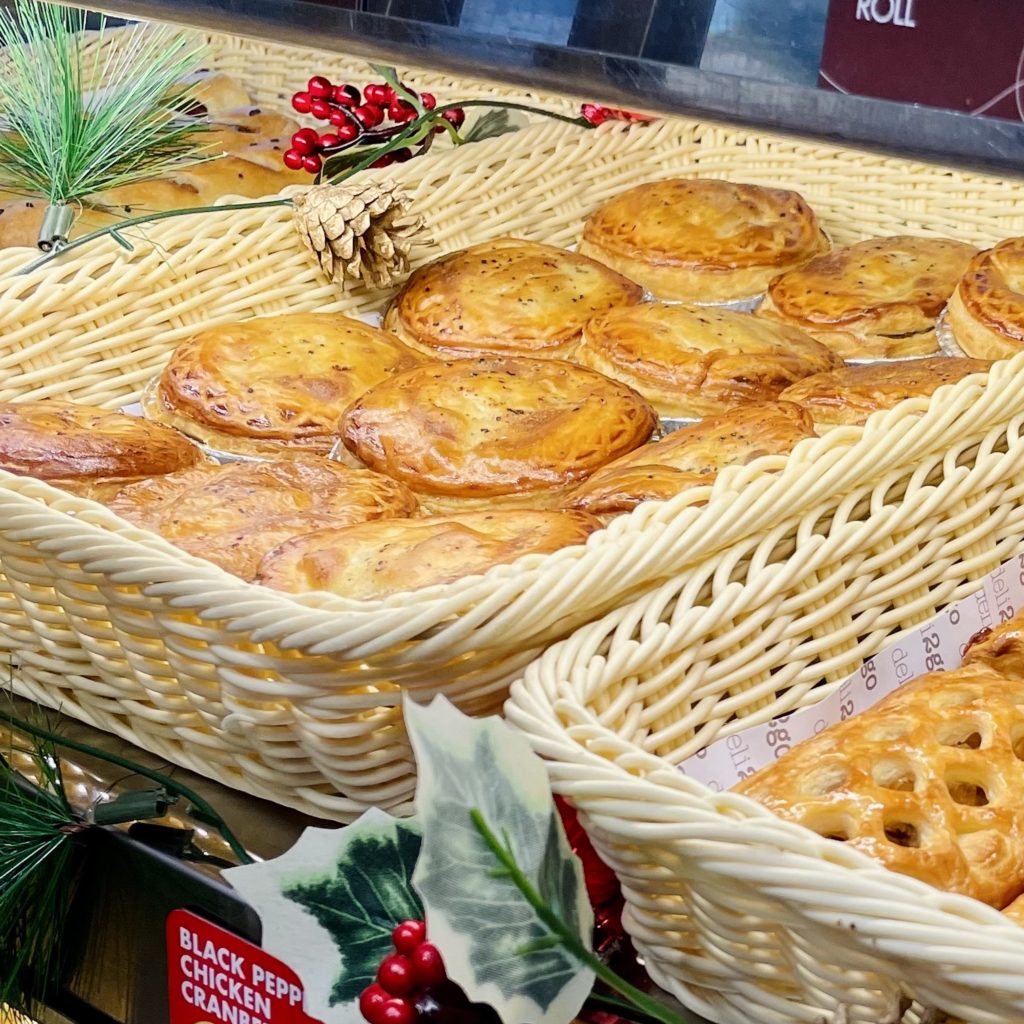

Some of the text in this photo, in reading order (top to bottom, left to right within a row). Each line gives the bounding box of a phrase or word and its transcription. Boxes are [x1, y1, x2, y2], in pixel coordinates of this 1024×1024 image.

[856, 0, 915, 28] ROLL
[179, 927, 303, 1006] BLACK PEPP
[180, 955, 271, 1020] CHICKEN
